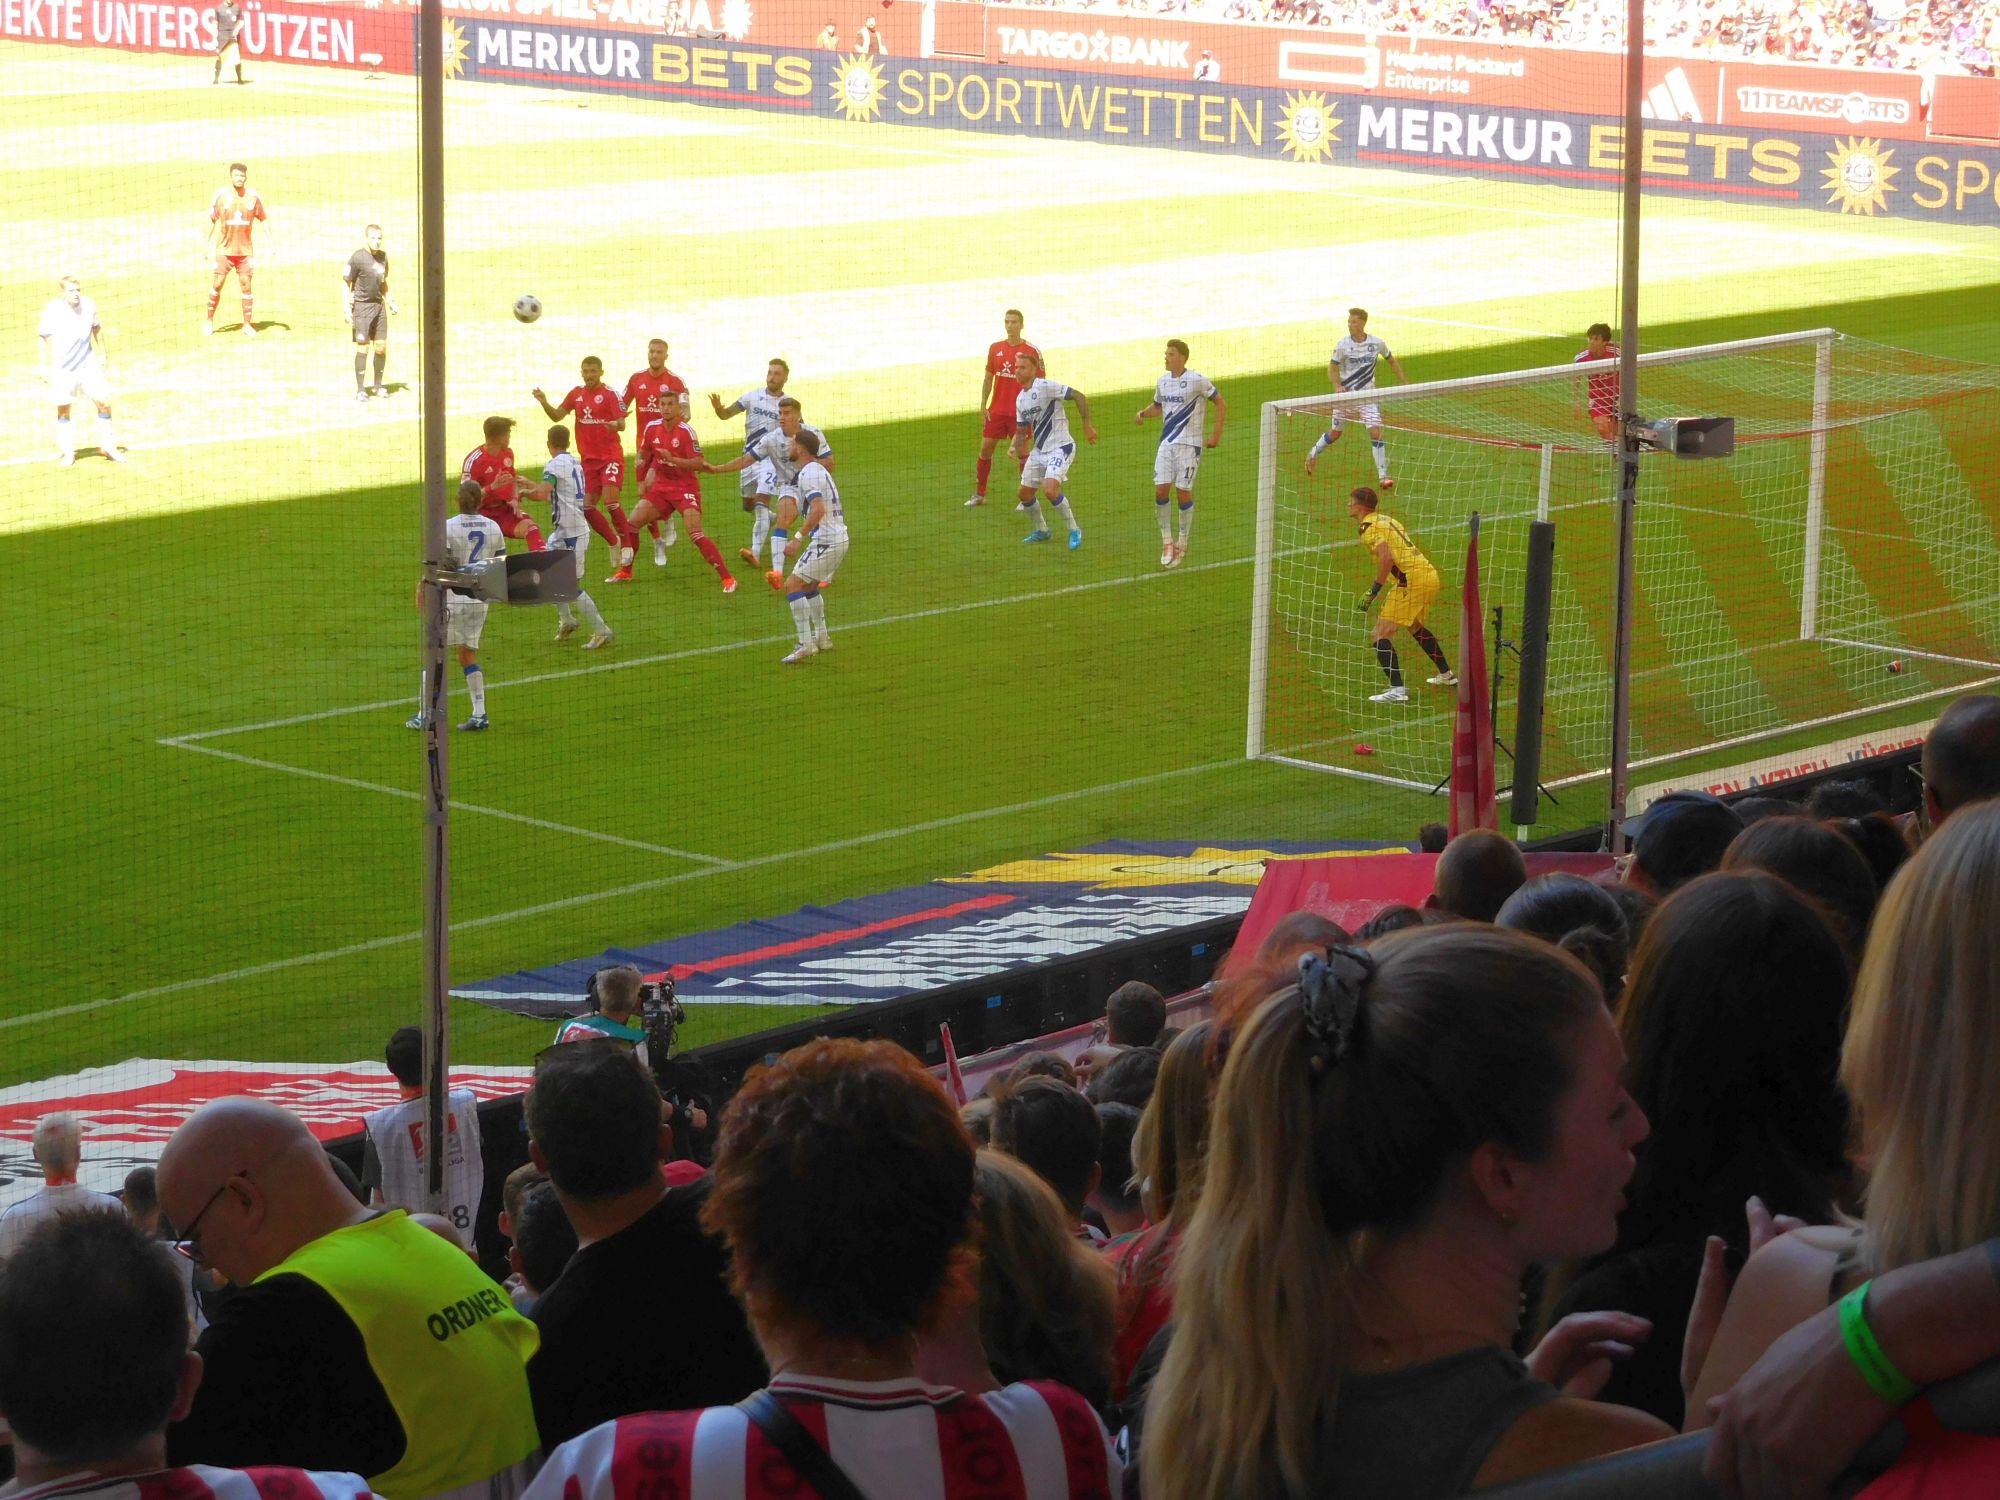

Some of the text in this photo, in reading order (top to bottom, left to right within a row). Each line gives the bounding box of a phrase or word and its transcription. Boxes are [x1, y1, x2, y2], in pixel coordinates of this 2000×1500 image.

[92, 0, 356, 64] UNTERSÜTZEN
[477, 27, 814, 97] MERKUR BETS
[1384, 69, 1471, 95] Enterprise
[896, 68, 1264, 147] SPORTWETTEN
[1357, 104, 1573, 166] MERKUR
[1911, 155, 2000, 211] SP
[605, 462, 620, 475] 25
[1049, 456, 1064, 468] 28
[467, 530, 485, 565] 2
[452, 1204, 471, 1230] 8
[426, 1287, 509, 1343] ORDNER
